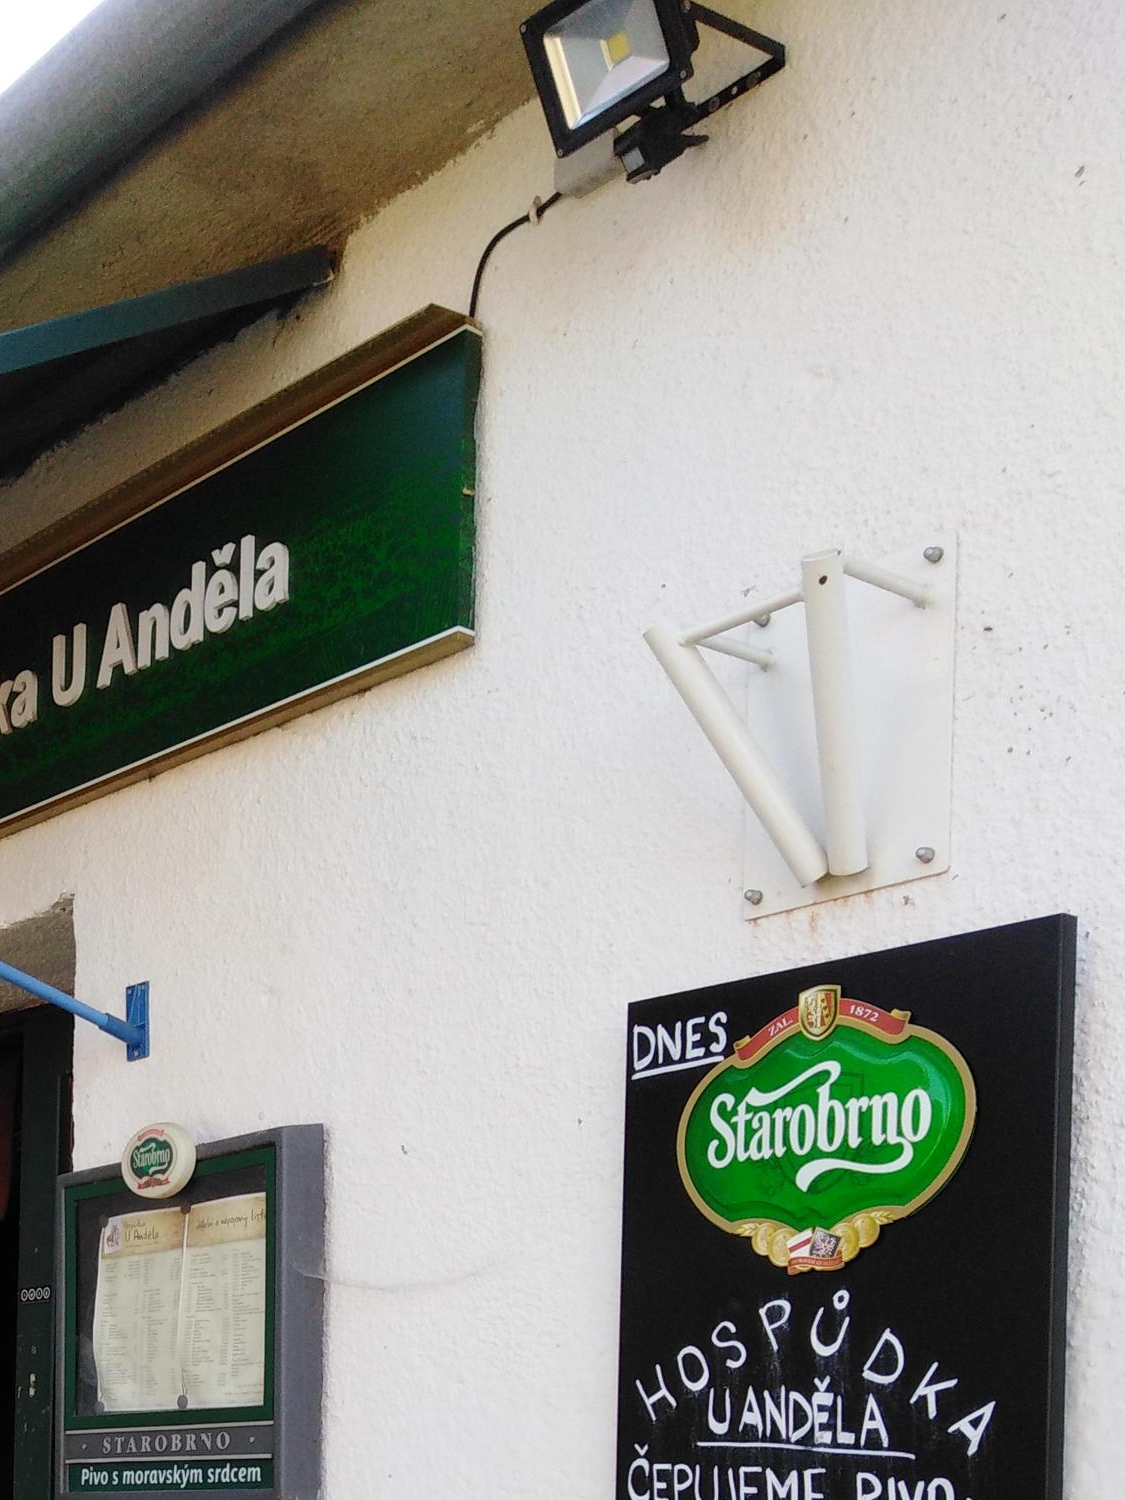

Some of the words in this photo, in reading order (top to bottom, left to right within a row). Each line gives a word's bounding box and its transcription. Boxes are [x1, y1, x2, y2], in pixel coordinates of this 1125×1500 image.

[51, 623, 87, 707] U
[96, 535, 290, 690] Anděla
[633, 1011, 728, 1070] DNES
[768, 1017, 793, 1037] ZAL.
[849, 1004, 880, 1022] 1872
[707, 1060, 932, 1192] Starobrno
[636, 1289, 996, 1456] HOSPŮDKA
[102, 1431, 231, 1455] STAROBRNO
[707, 1387, 731, 1434] U
[739, 1375, 888, 1448] ANDĚLA
[81, 1467, 109, 1487] Pivo
[111, 1473, 119, 1485] s
[122, 1463, 203, 1490] moravským
[208, 1464, 262, 1484] srdcem
